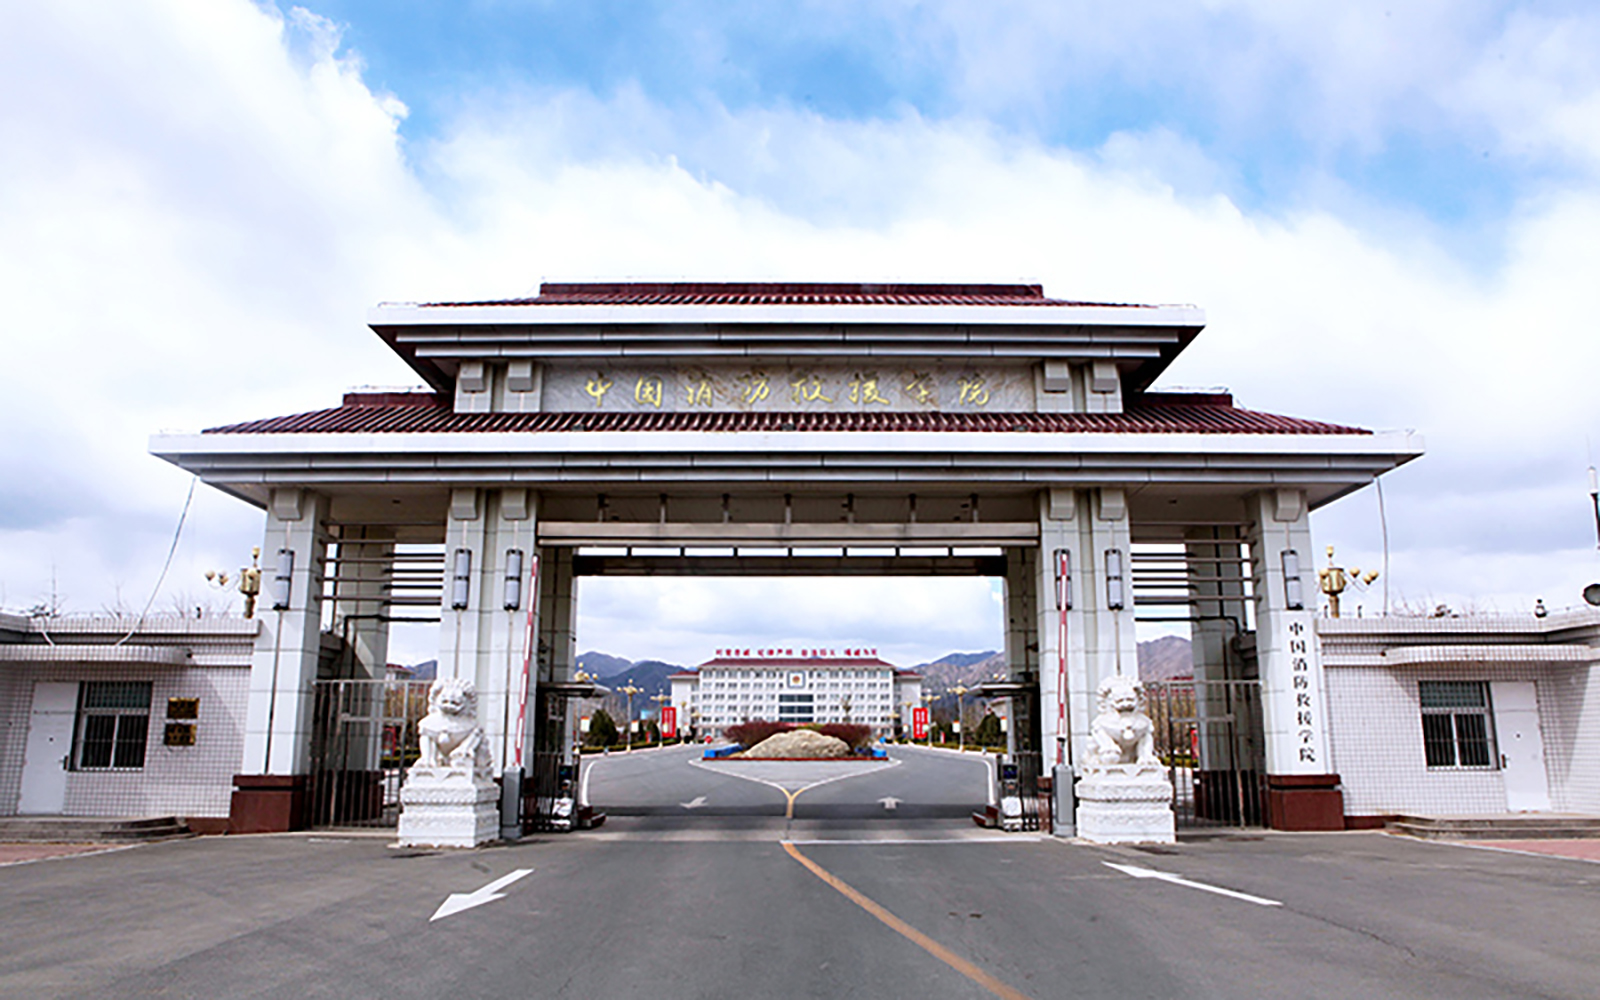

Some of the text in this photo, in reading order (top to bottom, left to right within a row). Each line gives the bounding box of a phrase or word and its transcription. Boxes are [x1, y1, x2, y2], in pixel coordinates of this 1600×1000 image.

[584, 371, 990, 408] 中国消防救援学院
[1288, 621, 1316, 763] 中国消防救援学院
